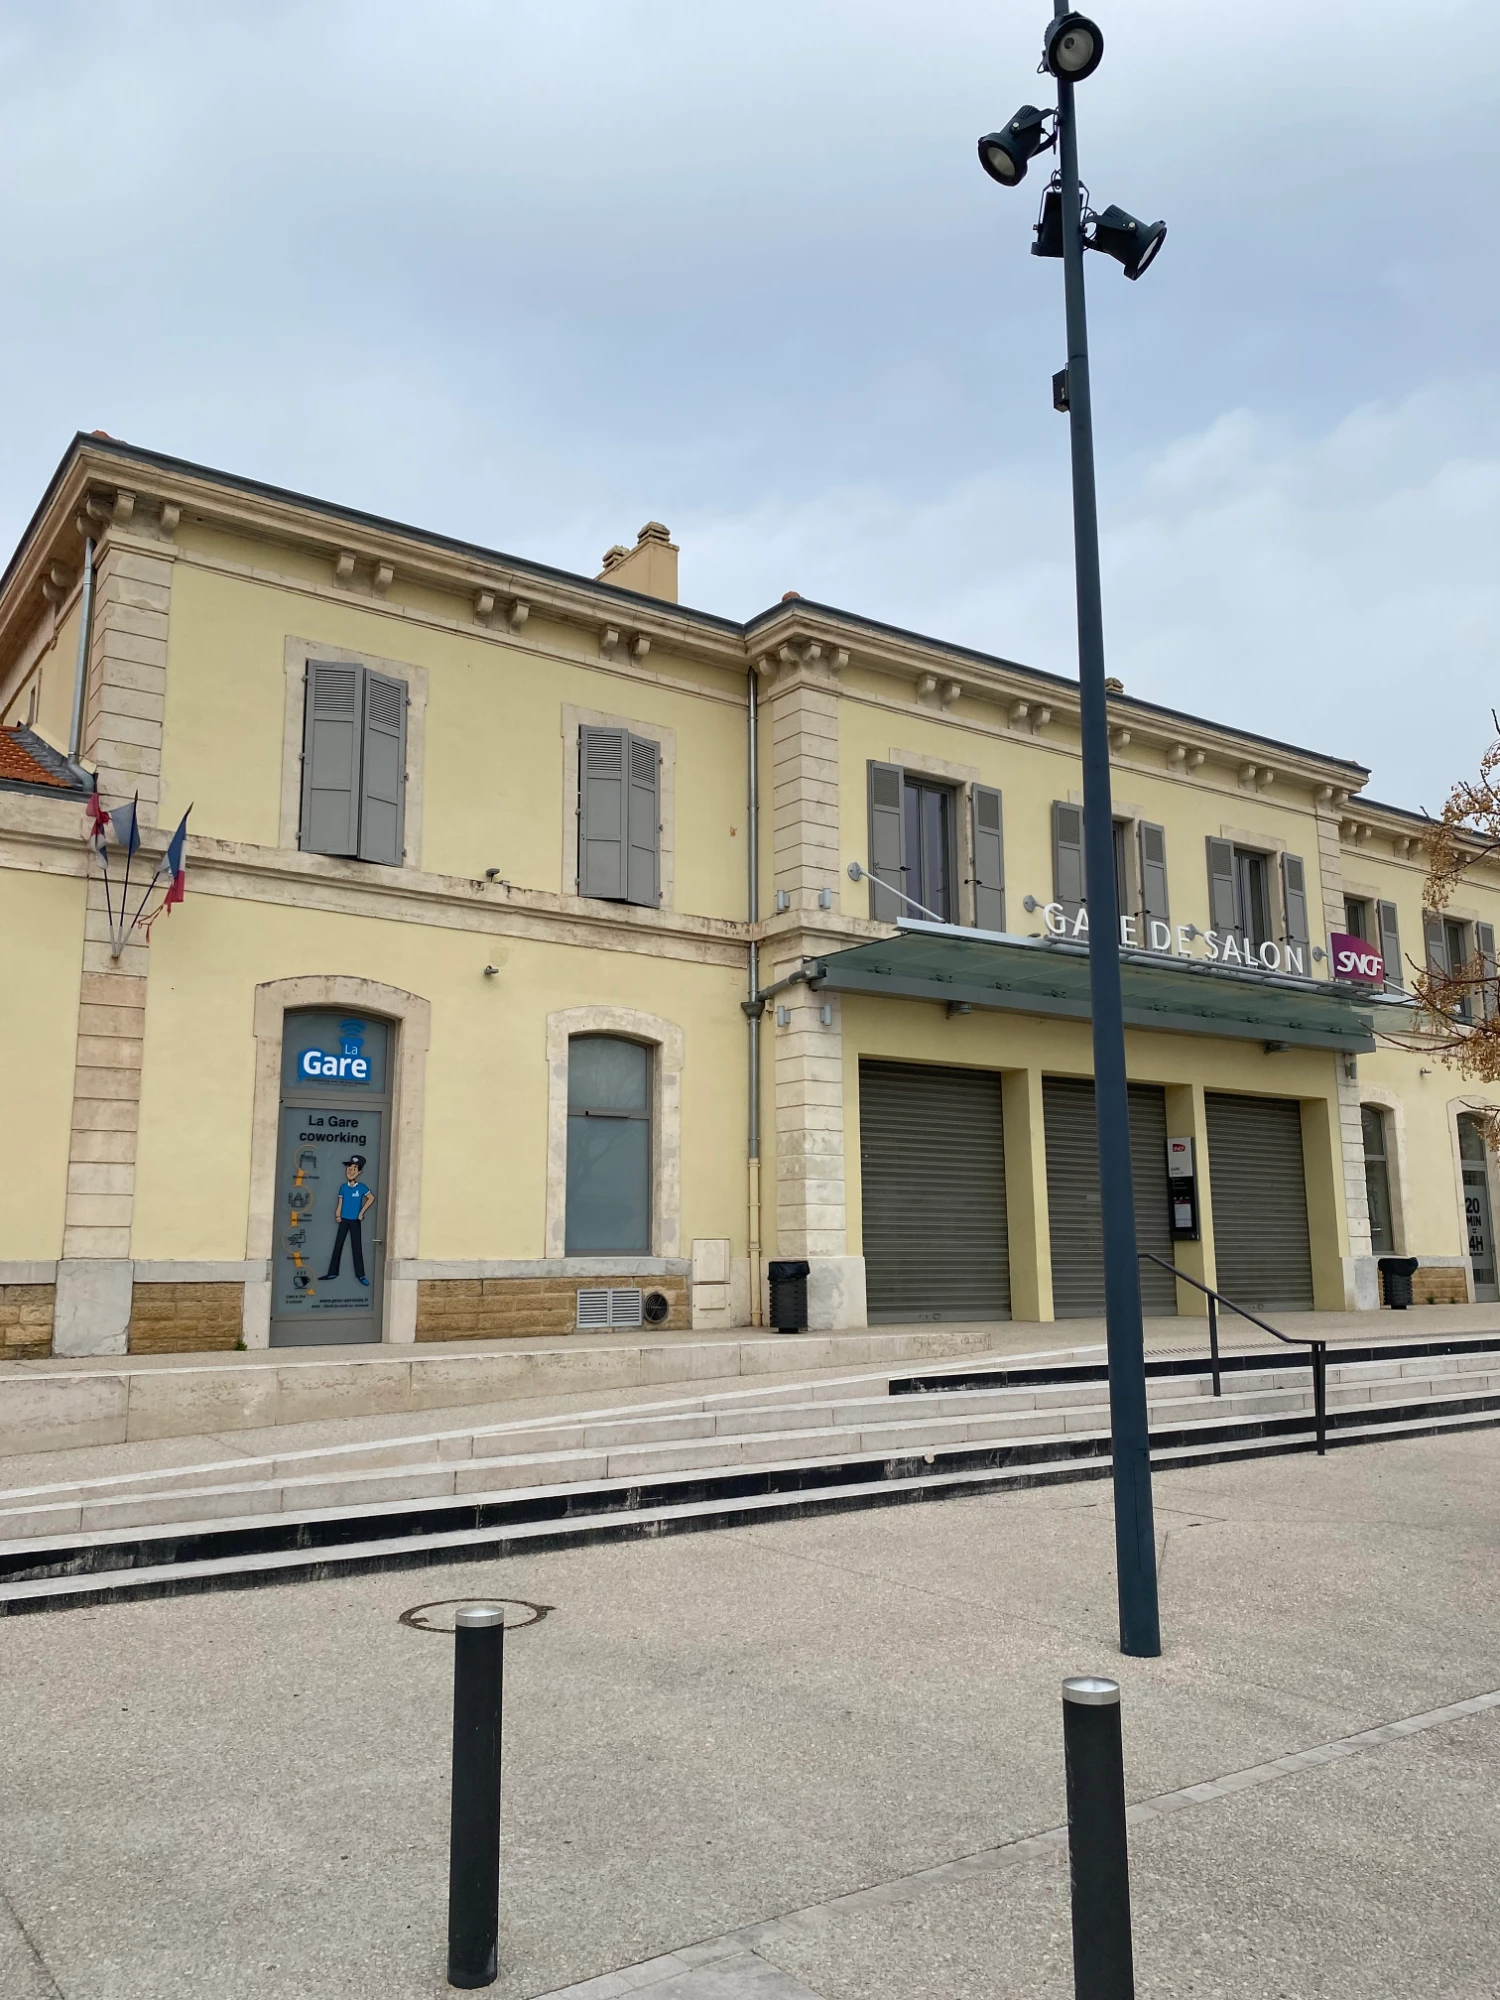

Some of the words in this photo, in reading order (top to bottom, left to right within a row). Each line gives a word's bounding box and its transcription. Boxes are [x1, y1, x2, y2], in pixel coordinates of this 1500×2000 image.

[1043, 903, 1138, 946] GAE
[1151, 921, 1193, 954] DE
[1203, 930, 1304, 974] SALON
[1336, 951, 1383, 976] SNCF
[344, 1044, 358, 1055] La
[303, 1051, 367, 1078] Gare
[308, 1114, 324, 1126] La
[328, 1116, 359, 1128] Gare
[299, 1131, 367, 1146] coworking
[1465, 1197, 1480, 1214] 20
[1466, 1215, 1482, 1227] MIN
[1469, 1235, 1484, 1251] 4H
